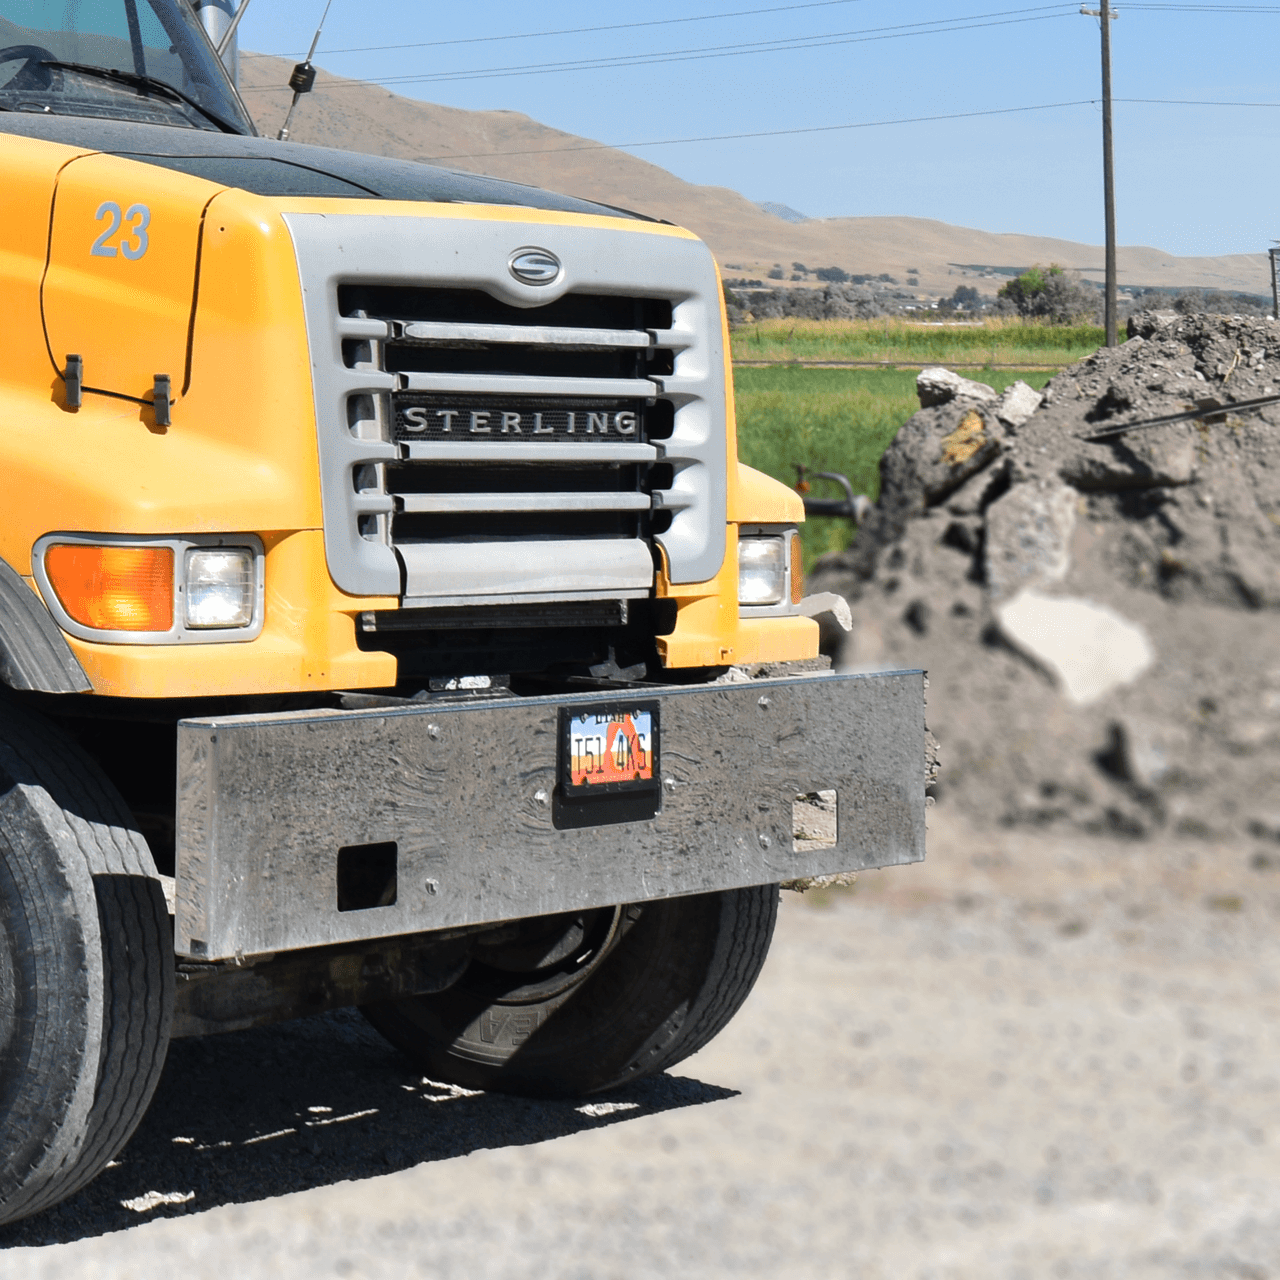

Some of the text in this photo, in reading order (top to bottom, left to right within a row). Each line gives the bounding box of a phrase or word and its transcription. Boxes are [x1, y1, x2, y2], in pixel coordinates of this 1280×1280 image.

[90, 201, 151, 261] 23
[404, 407, 637, 434] STERLING
[595, 713, 625, 725] UTAH
[574, 733, 647, 775] T51 4KS
